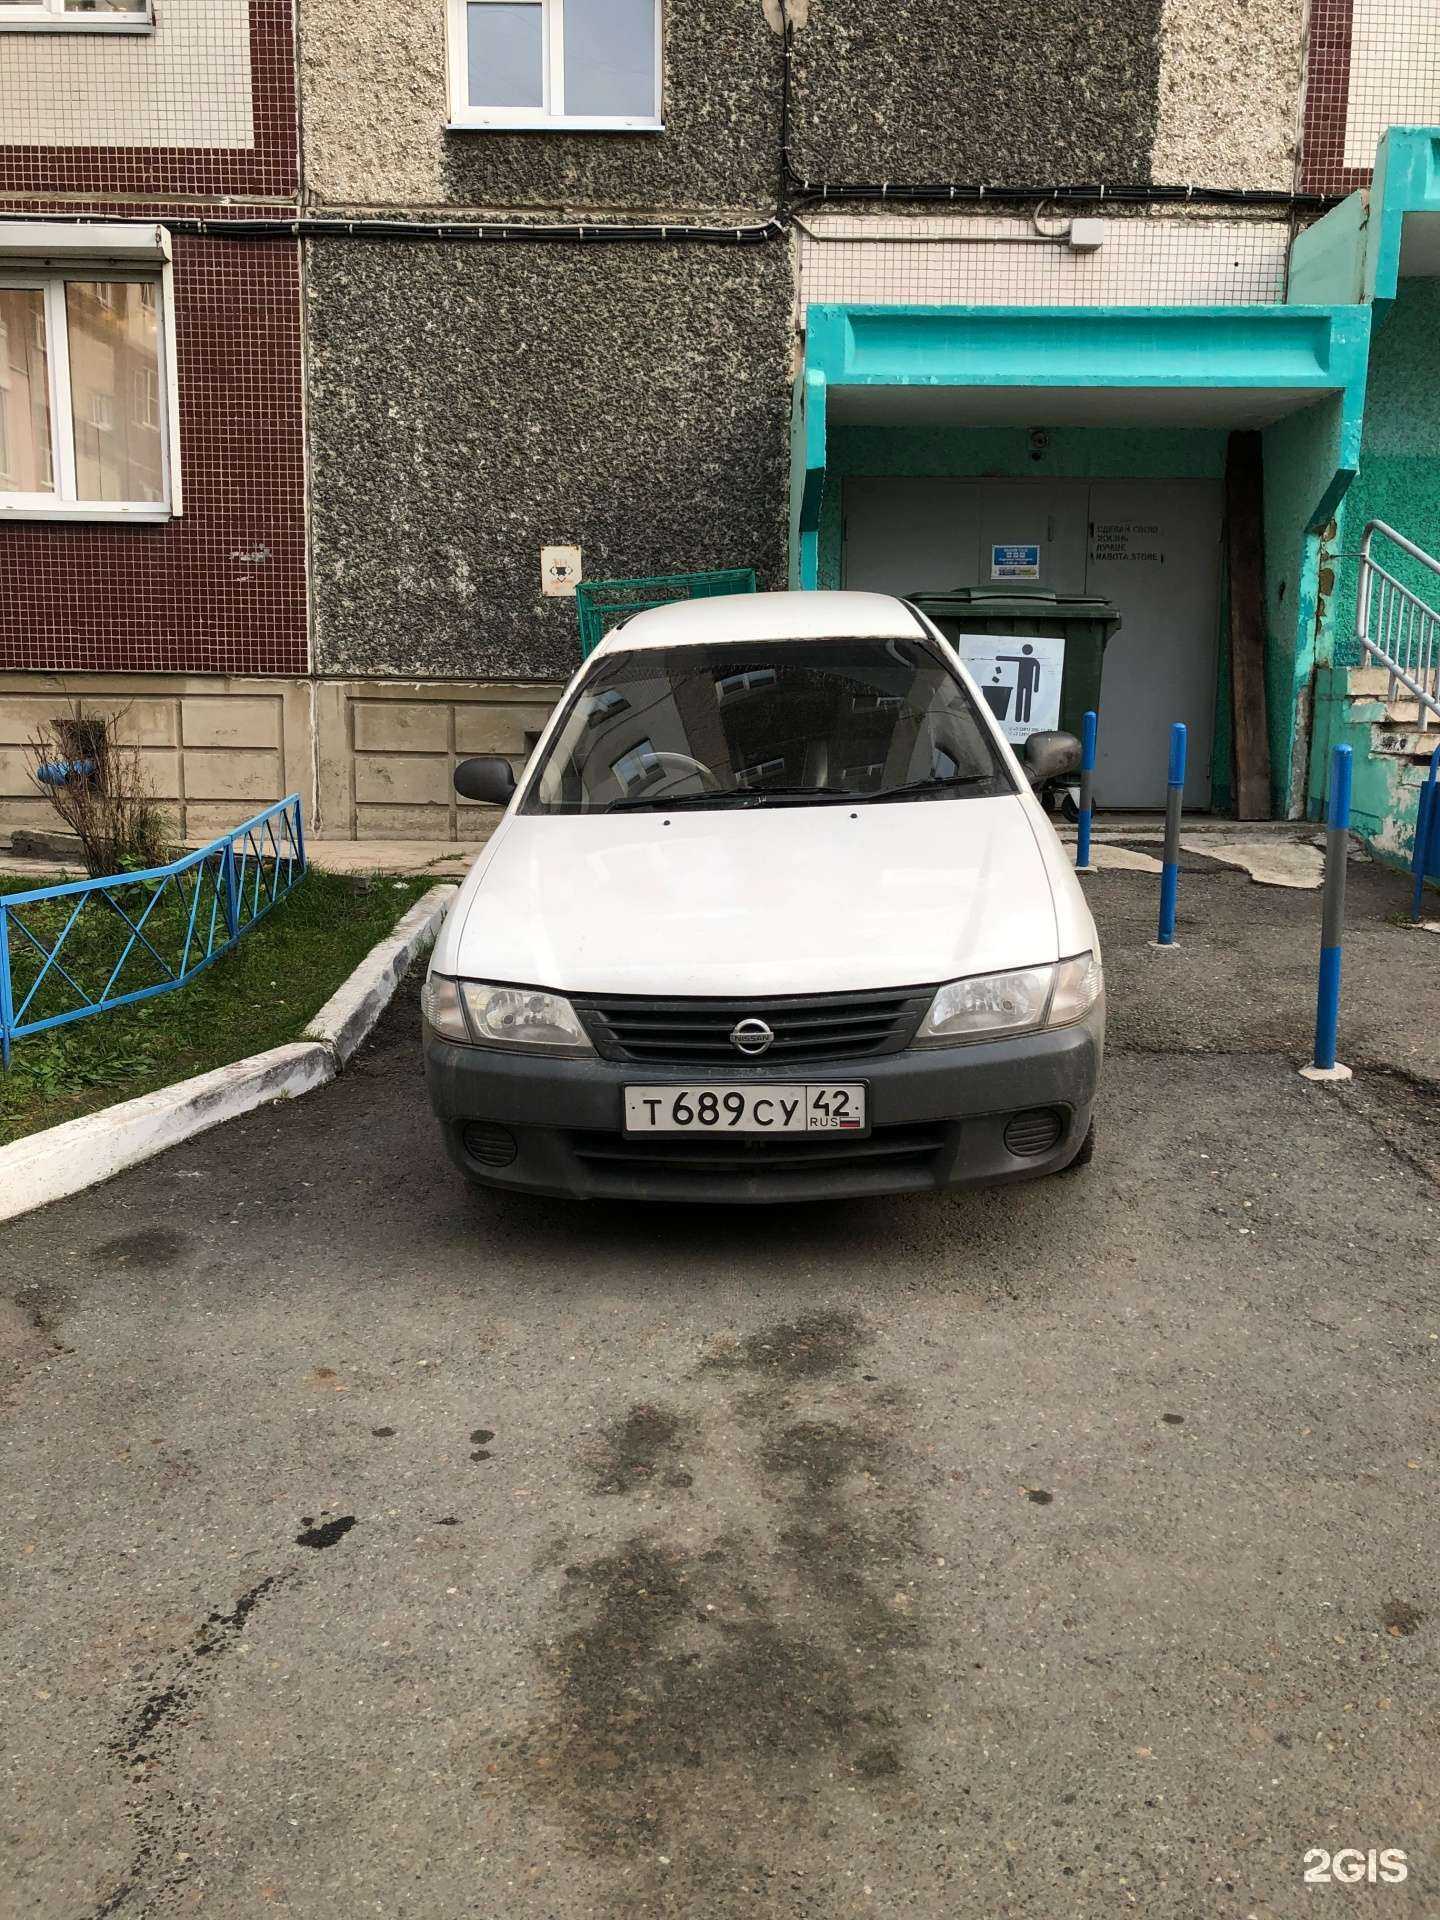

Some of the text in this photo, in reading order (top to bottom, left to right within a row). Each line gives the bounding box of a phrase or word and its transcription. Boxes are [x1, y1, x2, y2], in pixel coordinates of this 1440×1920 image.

[734, 1034, 768, 1042] NISSAN
[812, 1090, 850, 1117] 42
[809, 1117, 838, 1127] RUS
